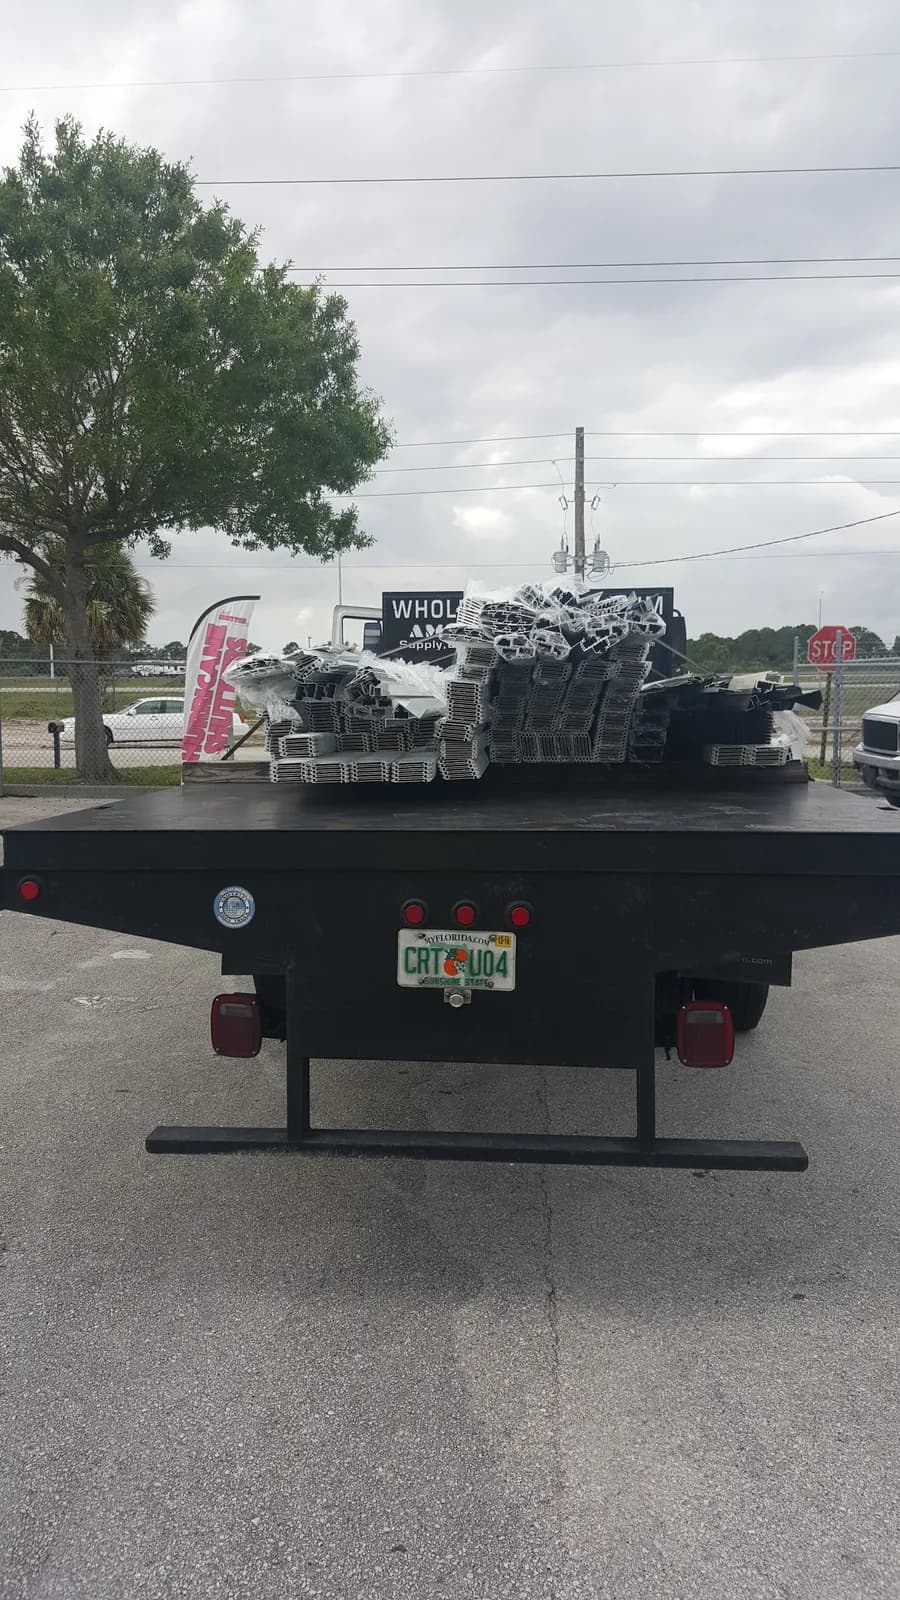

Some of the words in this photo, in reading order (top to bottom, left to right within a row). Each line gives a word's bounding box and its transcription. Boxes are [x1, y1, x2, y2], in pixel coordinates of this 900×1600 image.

[181, 623, 229, 761] HURRICANE
[404, 946, 441, 975] CRT
[469, 949, 508, 978] U04
[424, 976, 461, 986] SUNSHINE
[464, 978, 488, 987] STATE
